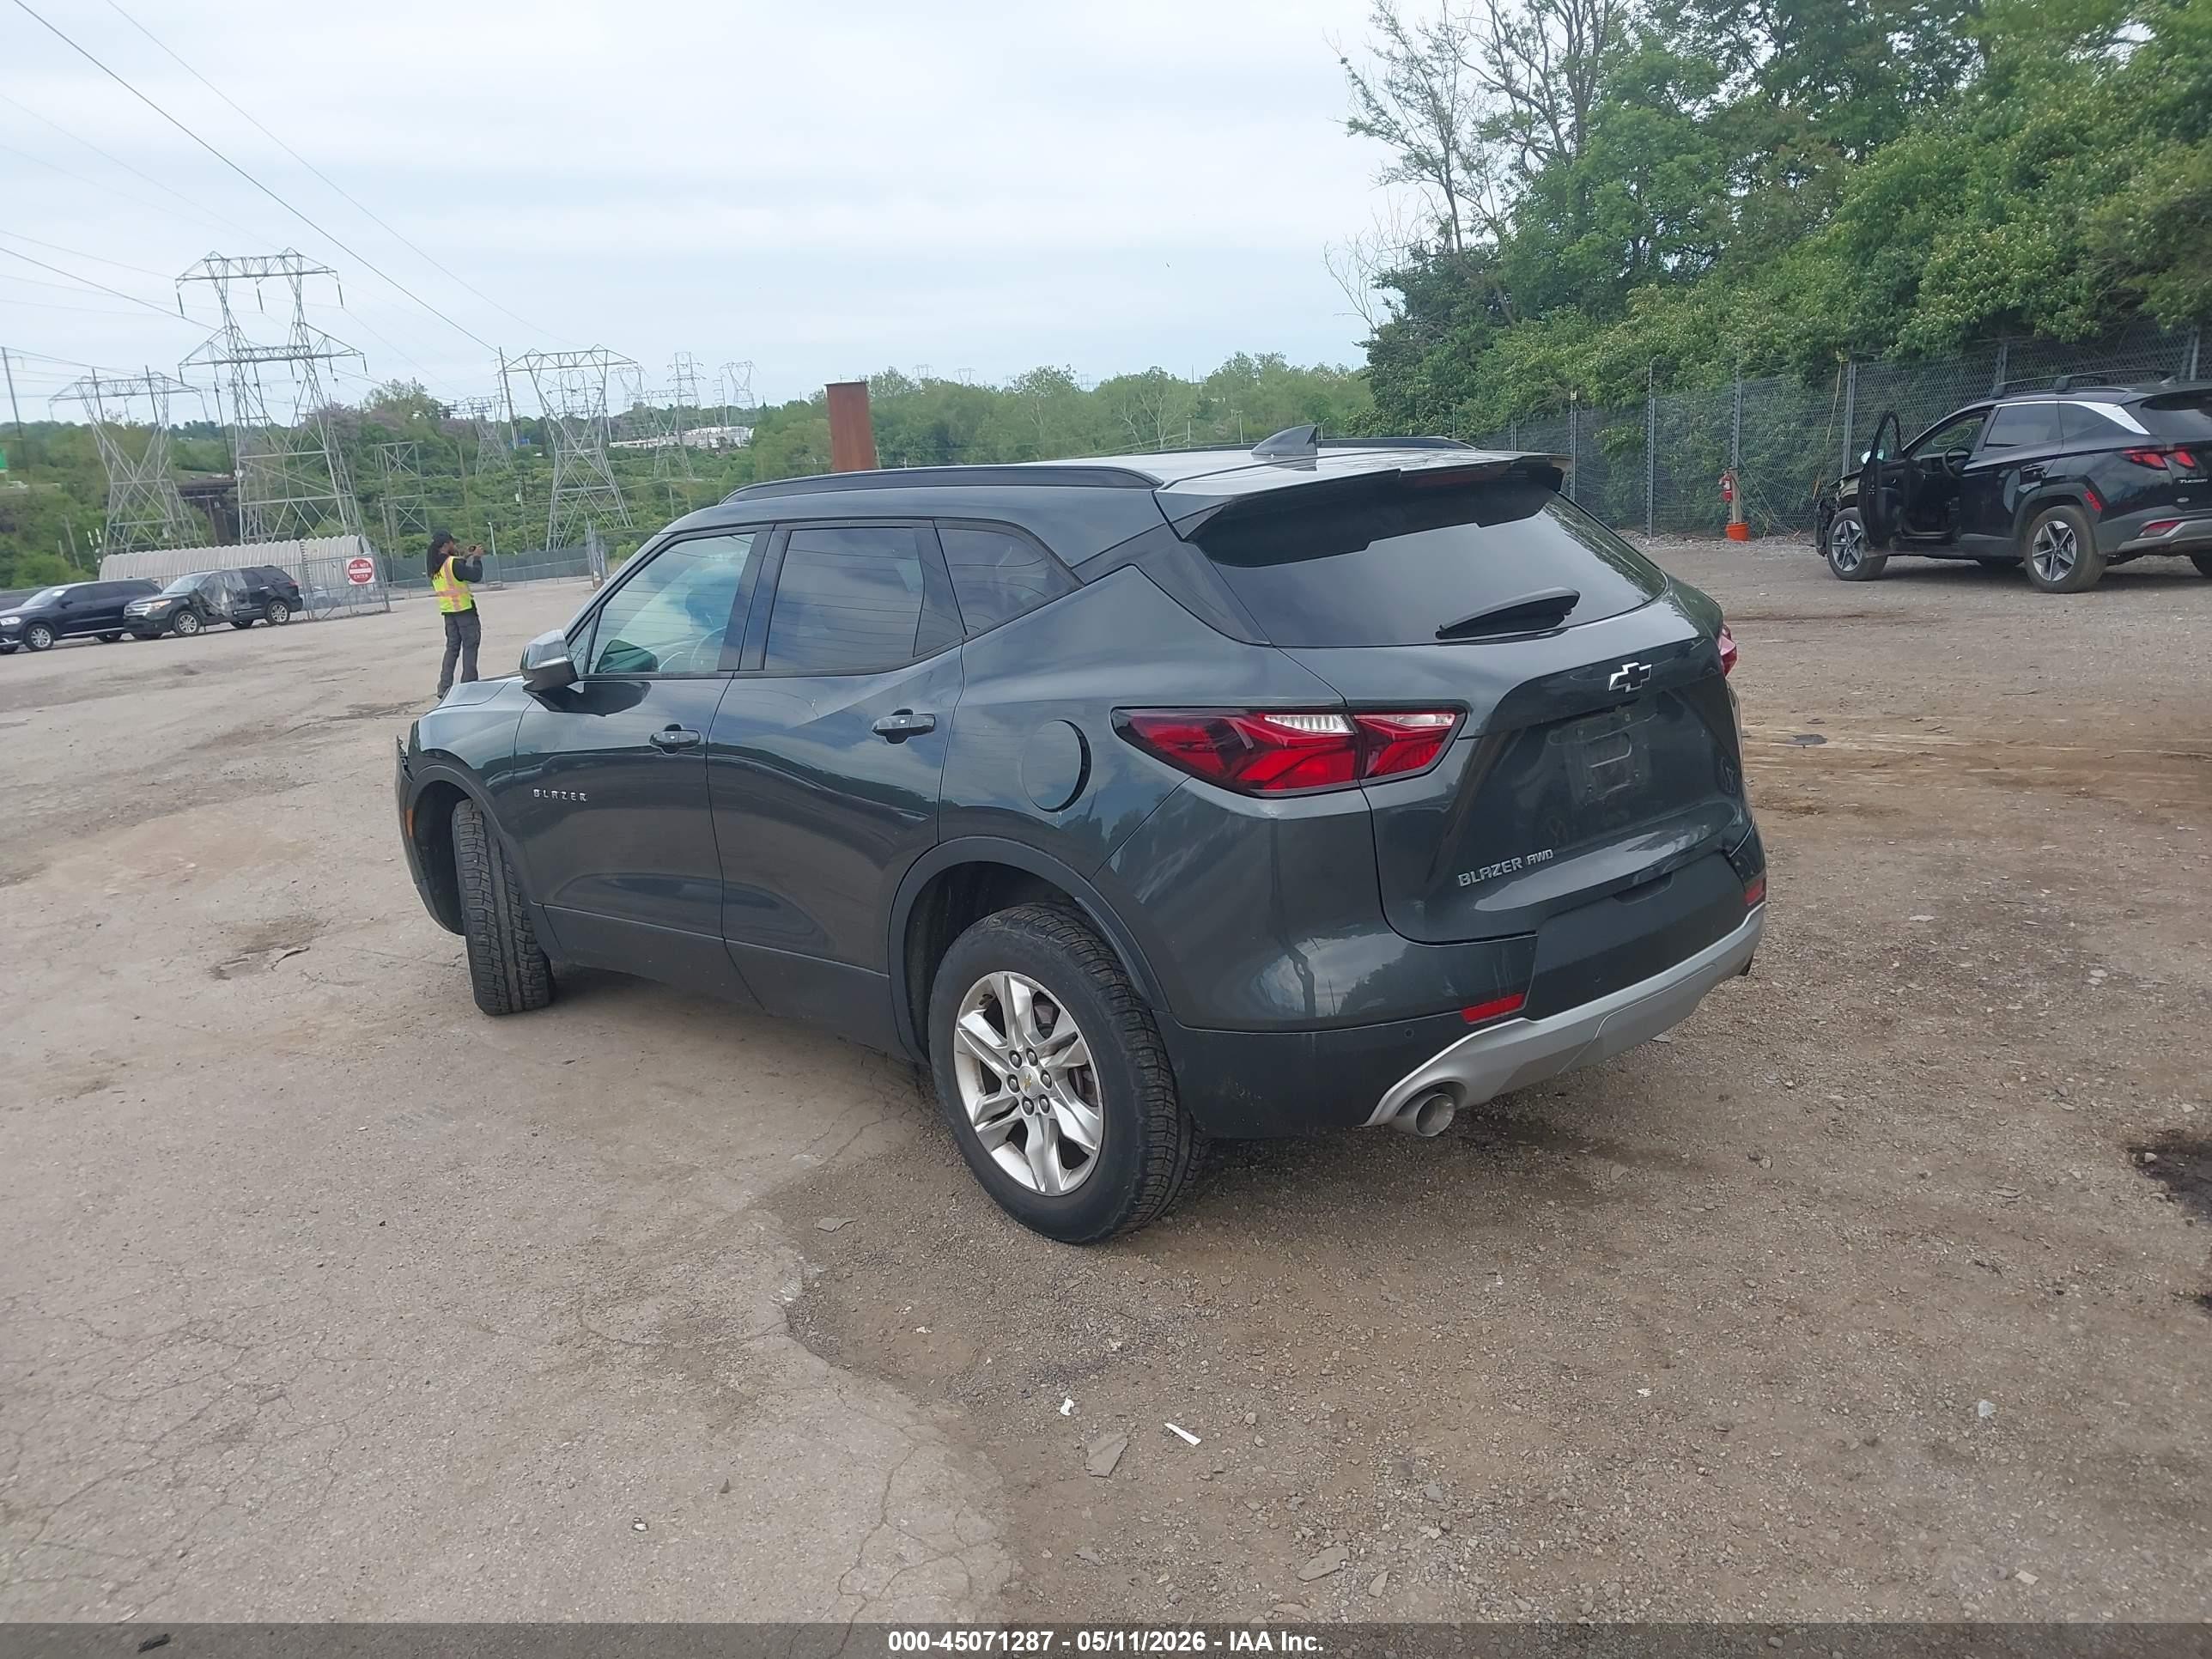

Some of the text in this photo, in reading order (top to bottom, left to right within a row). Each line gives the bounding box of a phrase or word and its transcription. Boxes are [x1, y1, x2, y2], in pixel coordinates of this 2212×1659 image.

[533, 788, 586, 802] BLAZER
[1458, 848, 1553, 887] BLAZER AWD
